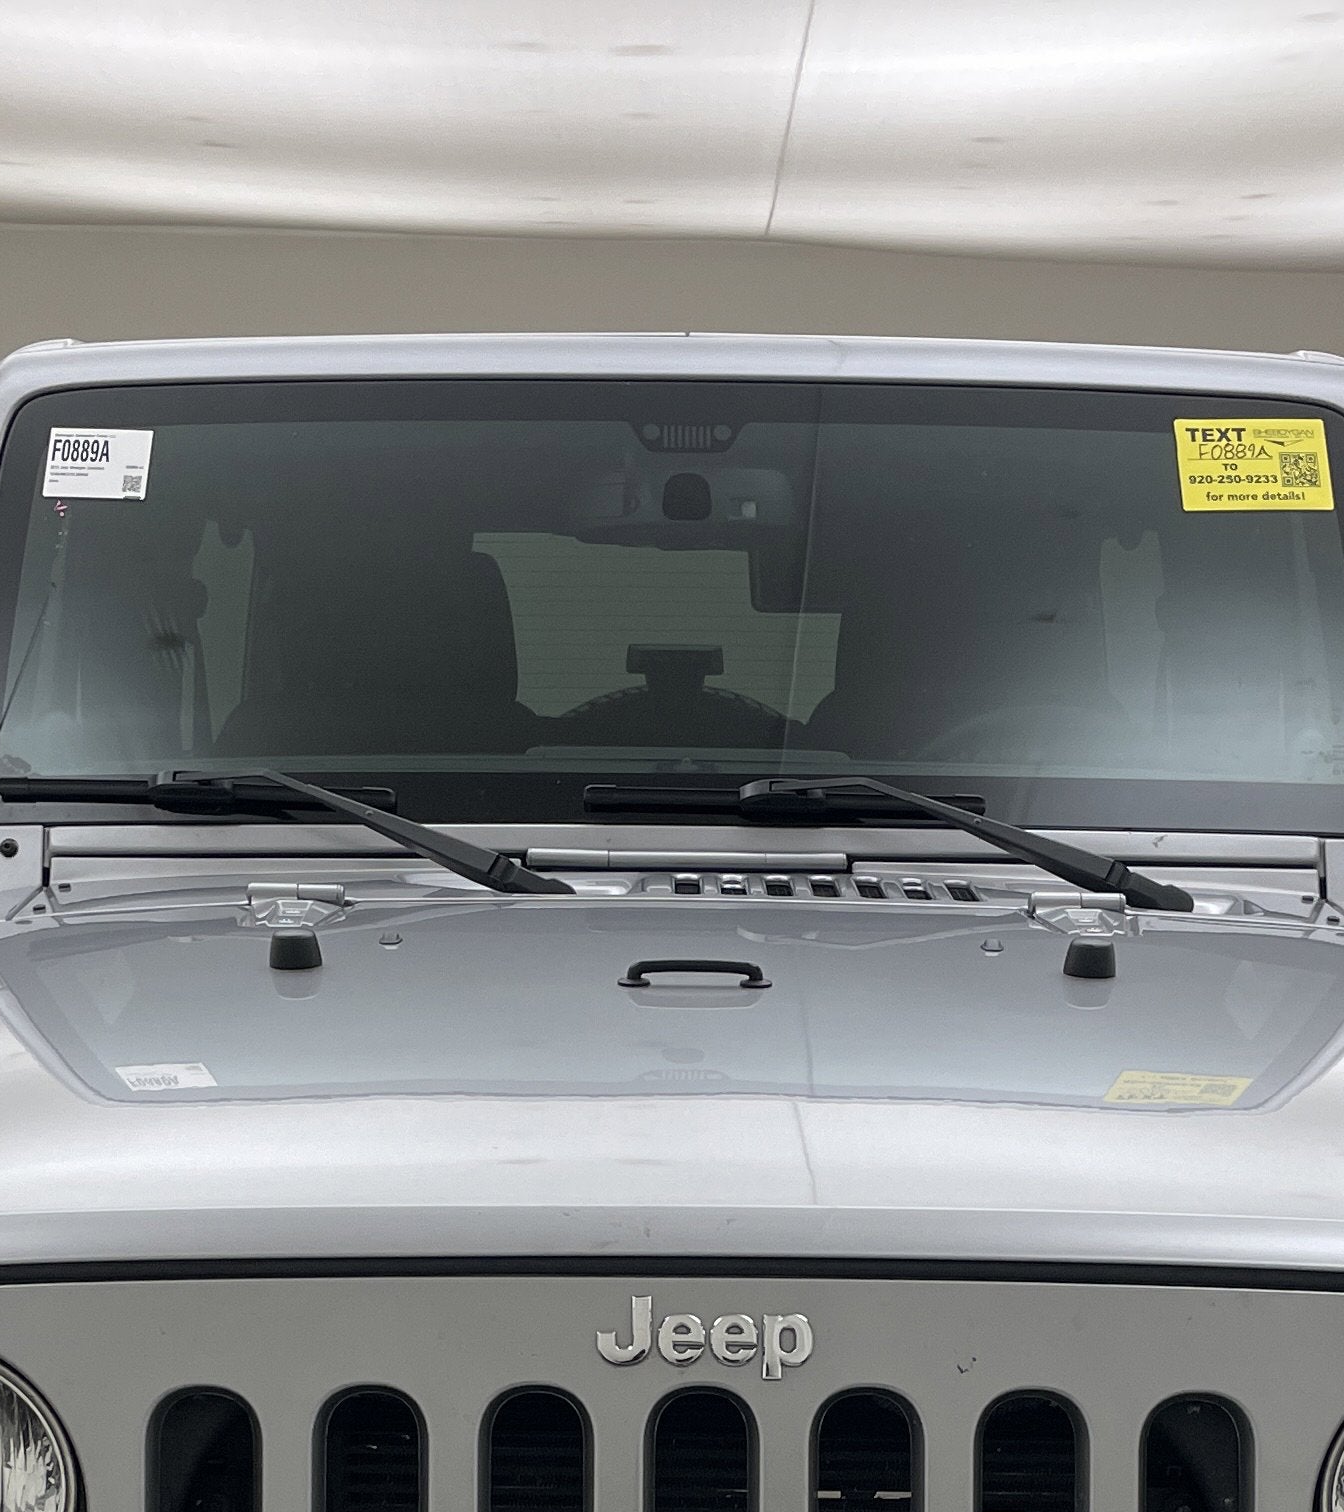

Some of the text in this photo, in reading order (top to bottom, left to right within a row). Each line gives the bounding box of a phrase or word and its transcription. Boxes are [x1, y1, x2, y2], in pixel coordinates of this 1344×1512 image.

[1185, 428, 1246, 442] TEXT
[51, 439, 110, 462] F0889A
[1198, 443, 1273, 460] F0889A
[1222, 463, 1238, 471] TO
[1189, 475, 1278, 484] 920-250-9233
[1206, 491, 1305, 501] for more details!
[597, 1296, 814, 1380] Jeep
